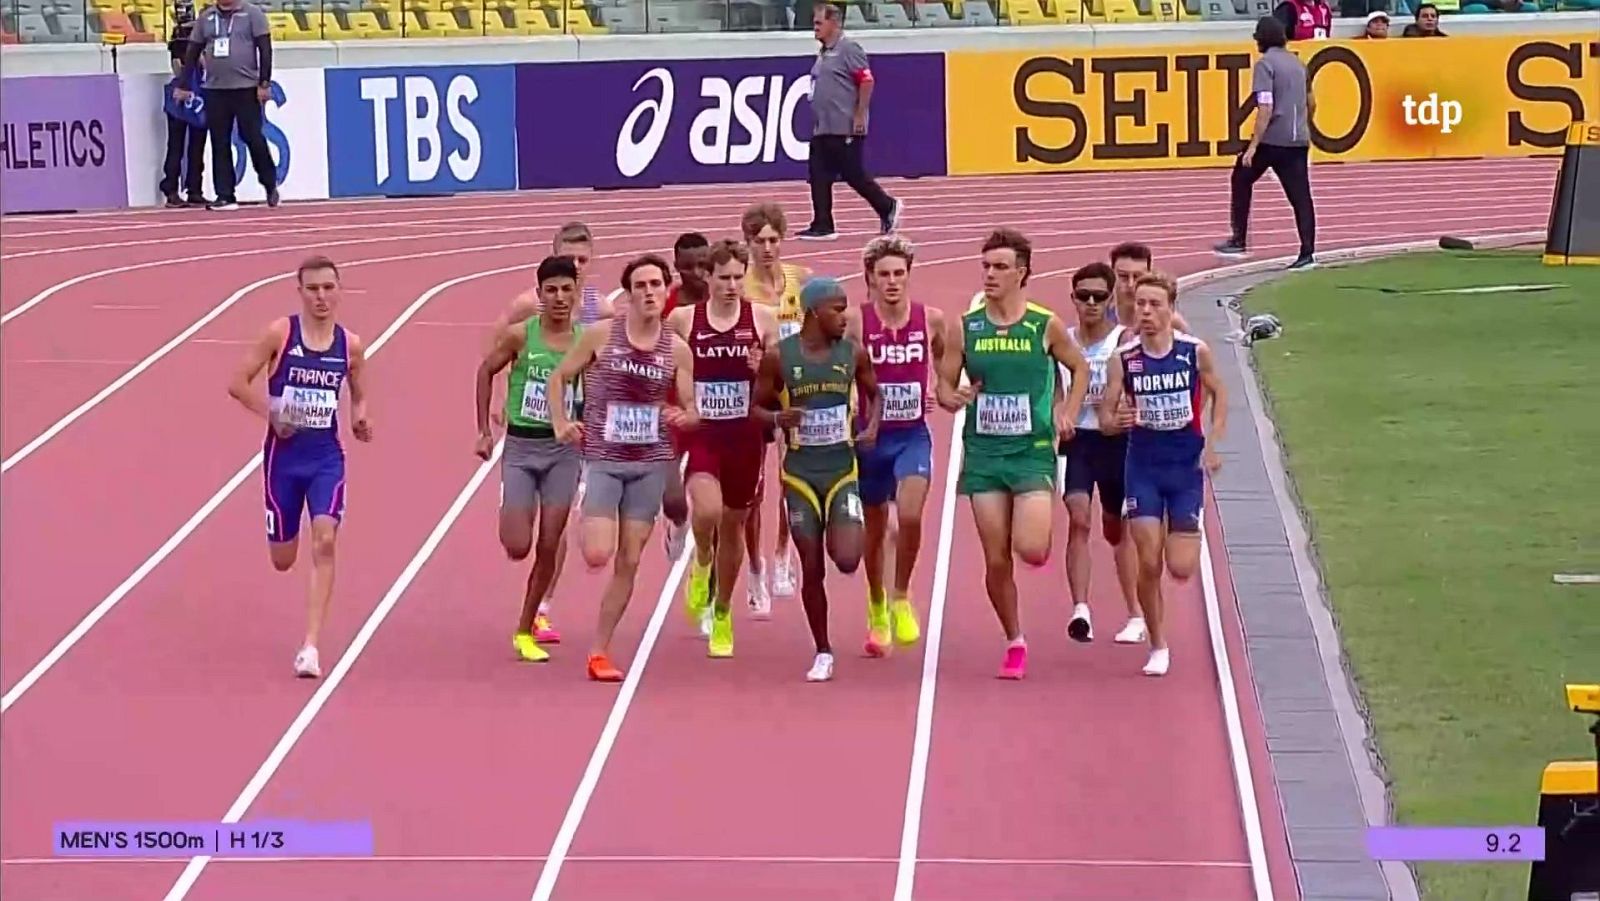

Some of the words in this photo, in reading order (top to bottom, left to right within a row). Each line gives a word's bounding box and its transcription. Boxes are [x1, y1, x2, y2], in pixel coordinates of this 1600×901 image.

[688, 74, 812, 165] asic
[361, 74, 482, 187] TBS
[696, 345, 751, 358] LATVIA
[974, 338, 1032, 353] AUSTRALIA
[868, 343, 924, 364] USA
[288, 366, 342, 388] FRANCE
[1132, 370, 1191, 392] NORWAY
[704, 383, 740, 395] NTN
[293, 390, 328, 403] NTN
[701, 396, 744, 410] KUDLIS
[985, 395, 1019, 406] NTN
[1146, 393, 1181, 407] NTN
[979, 408, 1028, 423] WILLIAMS
[1163, 406, 1190, 420] BERG
